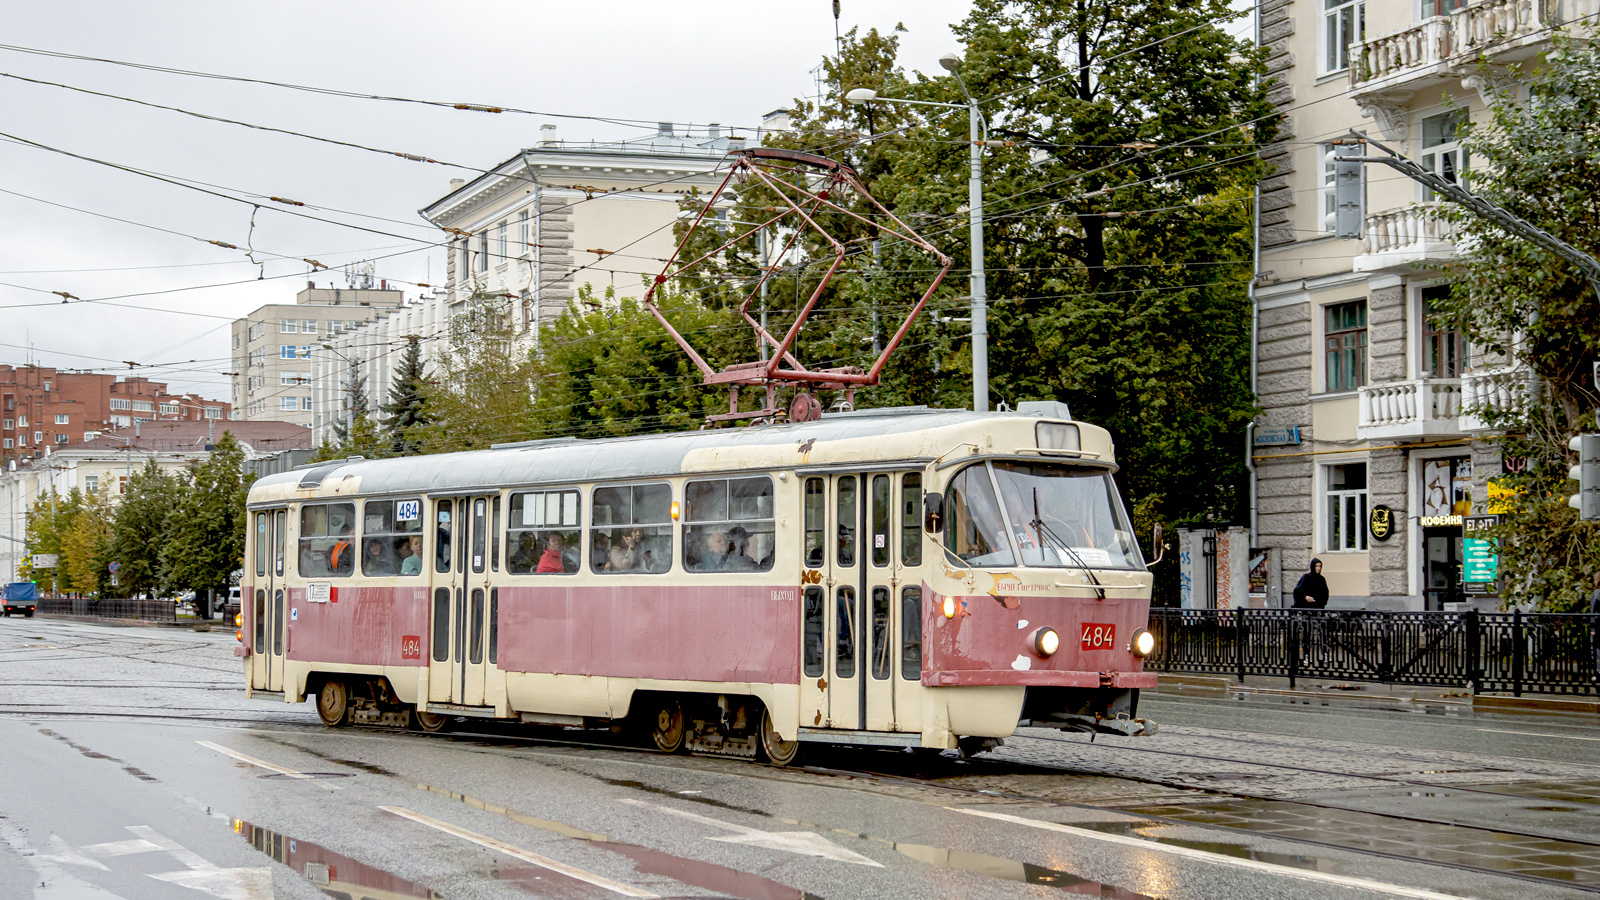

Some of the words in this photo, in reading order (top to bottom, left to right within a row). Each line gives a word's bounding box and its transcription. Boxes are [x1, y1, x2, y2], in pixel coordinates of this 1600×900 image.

[399, 502, 418, 519] 484
[1420, 513, 1463, 526] КОФЕЙНЯ
[770, 590, 795, 602] ВЫХОД
[1082, 626, 1113, 648] 484
[402, 640, 420, 656] 484
